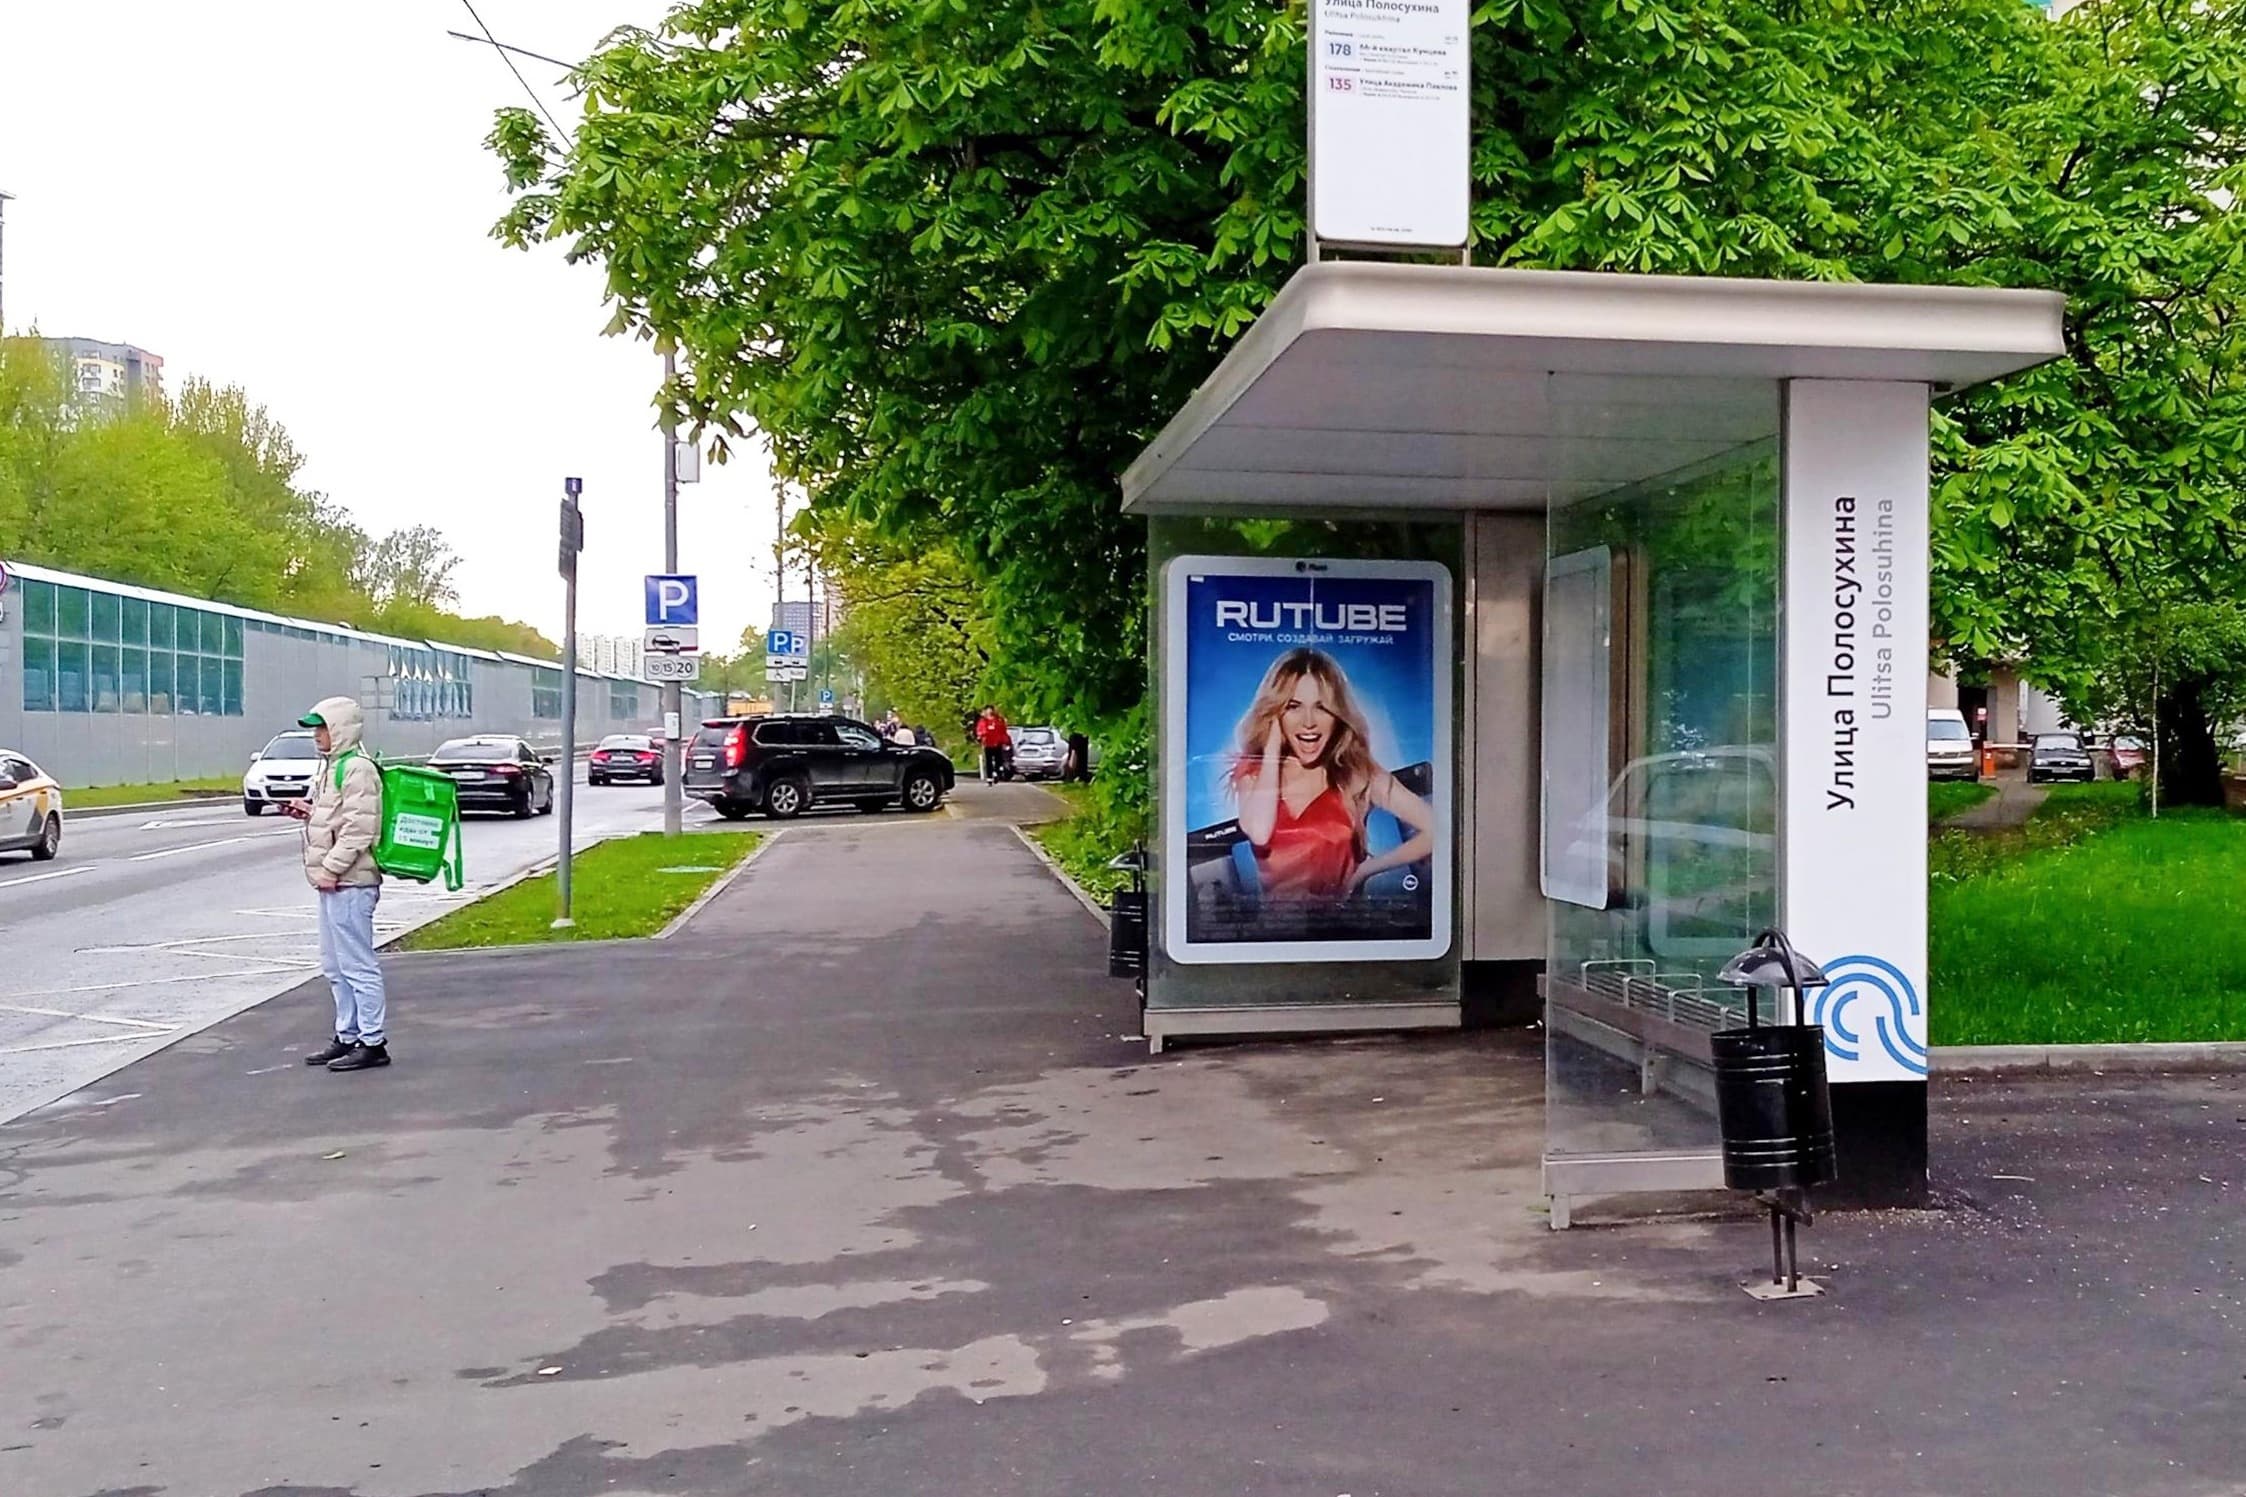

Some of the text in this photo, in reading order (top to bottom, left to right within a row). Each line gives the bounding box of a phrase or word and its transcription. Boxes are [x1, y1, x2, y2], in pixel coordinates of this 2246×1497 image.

[1366, 0, 1440, 14] Полосухина
[1329, 42, 1352, 56] 178
[1329, 77, 1353, 91] 135
[659, 579, 690, 620] P
[1871, 498, 1893, 720] Ulitsa Polosuhina
[1216, 600, 1407, 631] RUTUBE
[1827, 496, 1862, 810] Улица Полосухина
[664, 661, 674, 672] 15
[677, 661, 693, 674] 20
